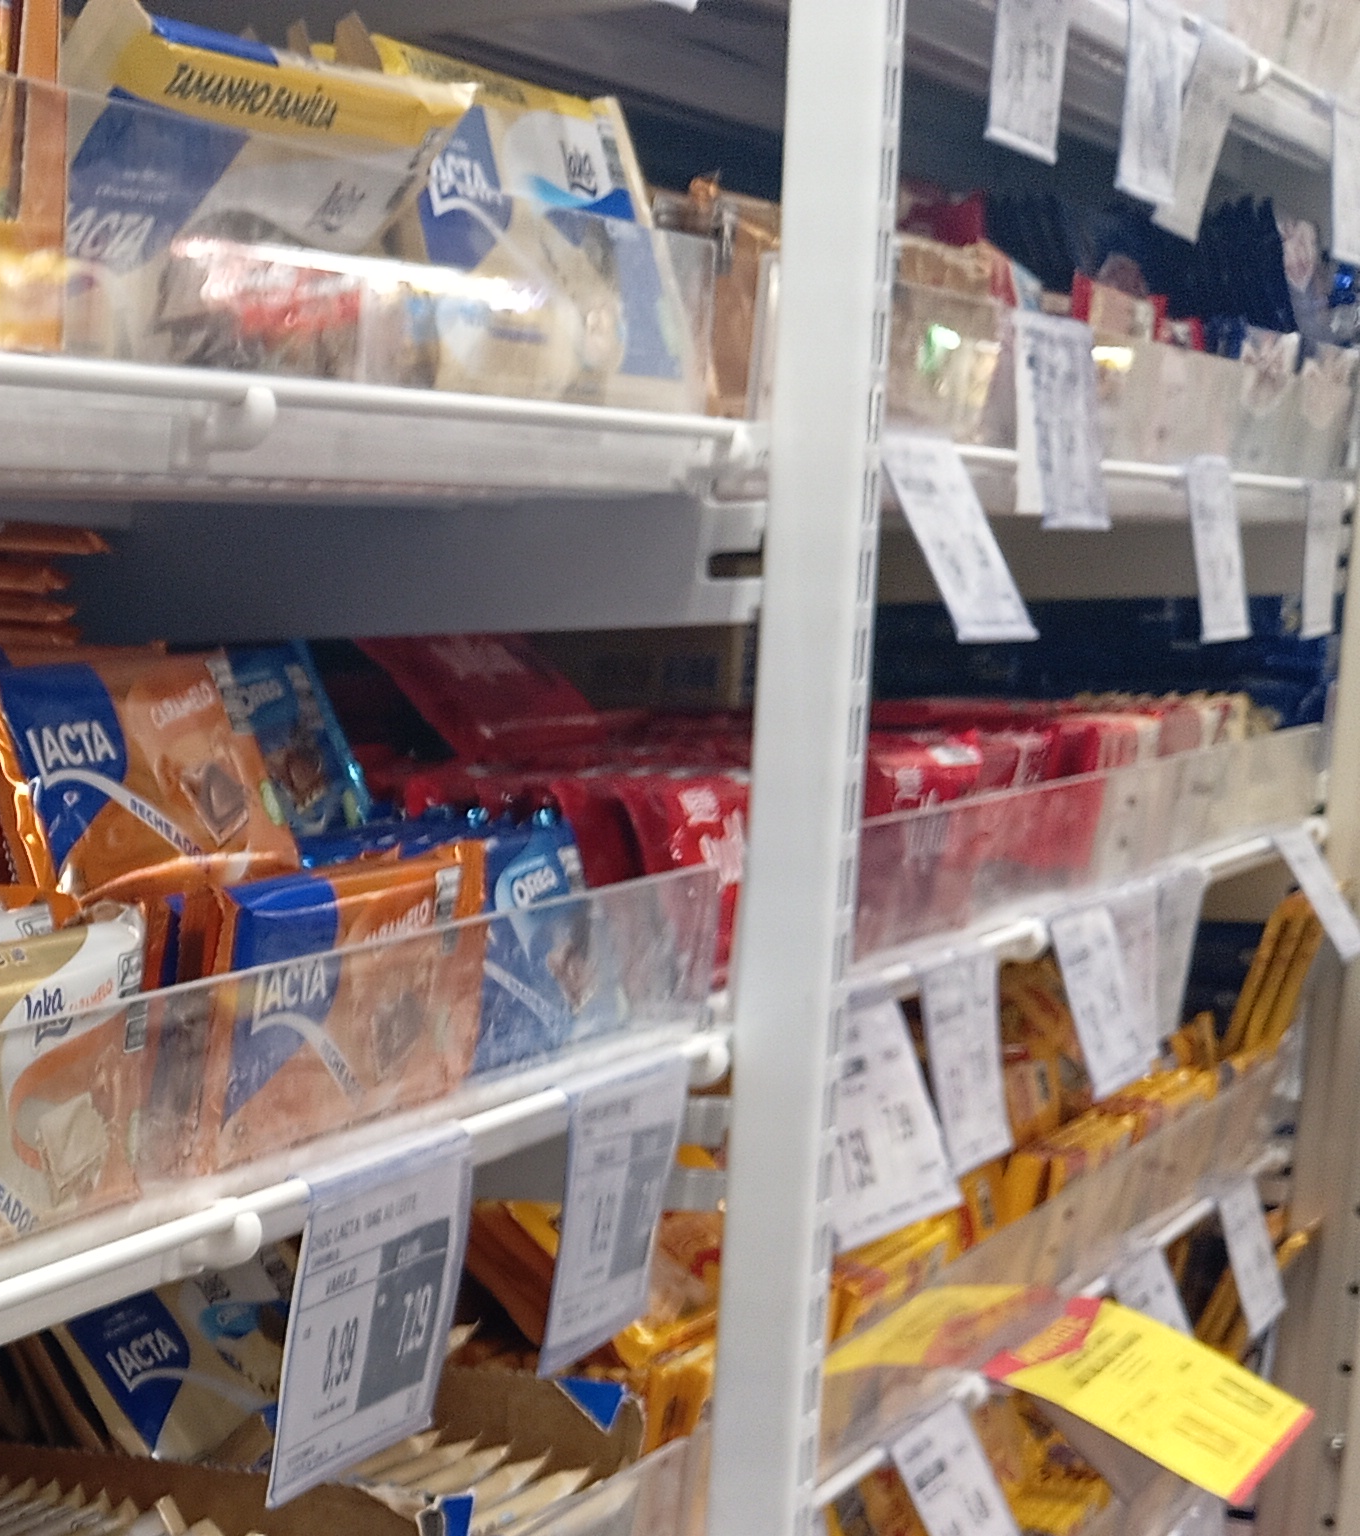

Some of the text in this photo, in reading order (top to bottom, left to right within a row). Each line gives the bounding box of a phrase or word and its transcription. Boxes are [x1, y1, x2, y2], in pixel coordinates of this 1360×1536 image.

[167, 62, 273, 113] TAMANHO
[27, 720, 118, 786] LACTA
[105, 1328, 179, 1392] LACTA
